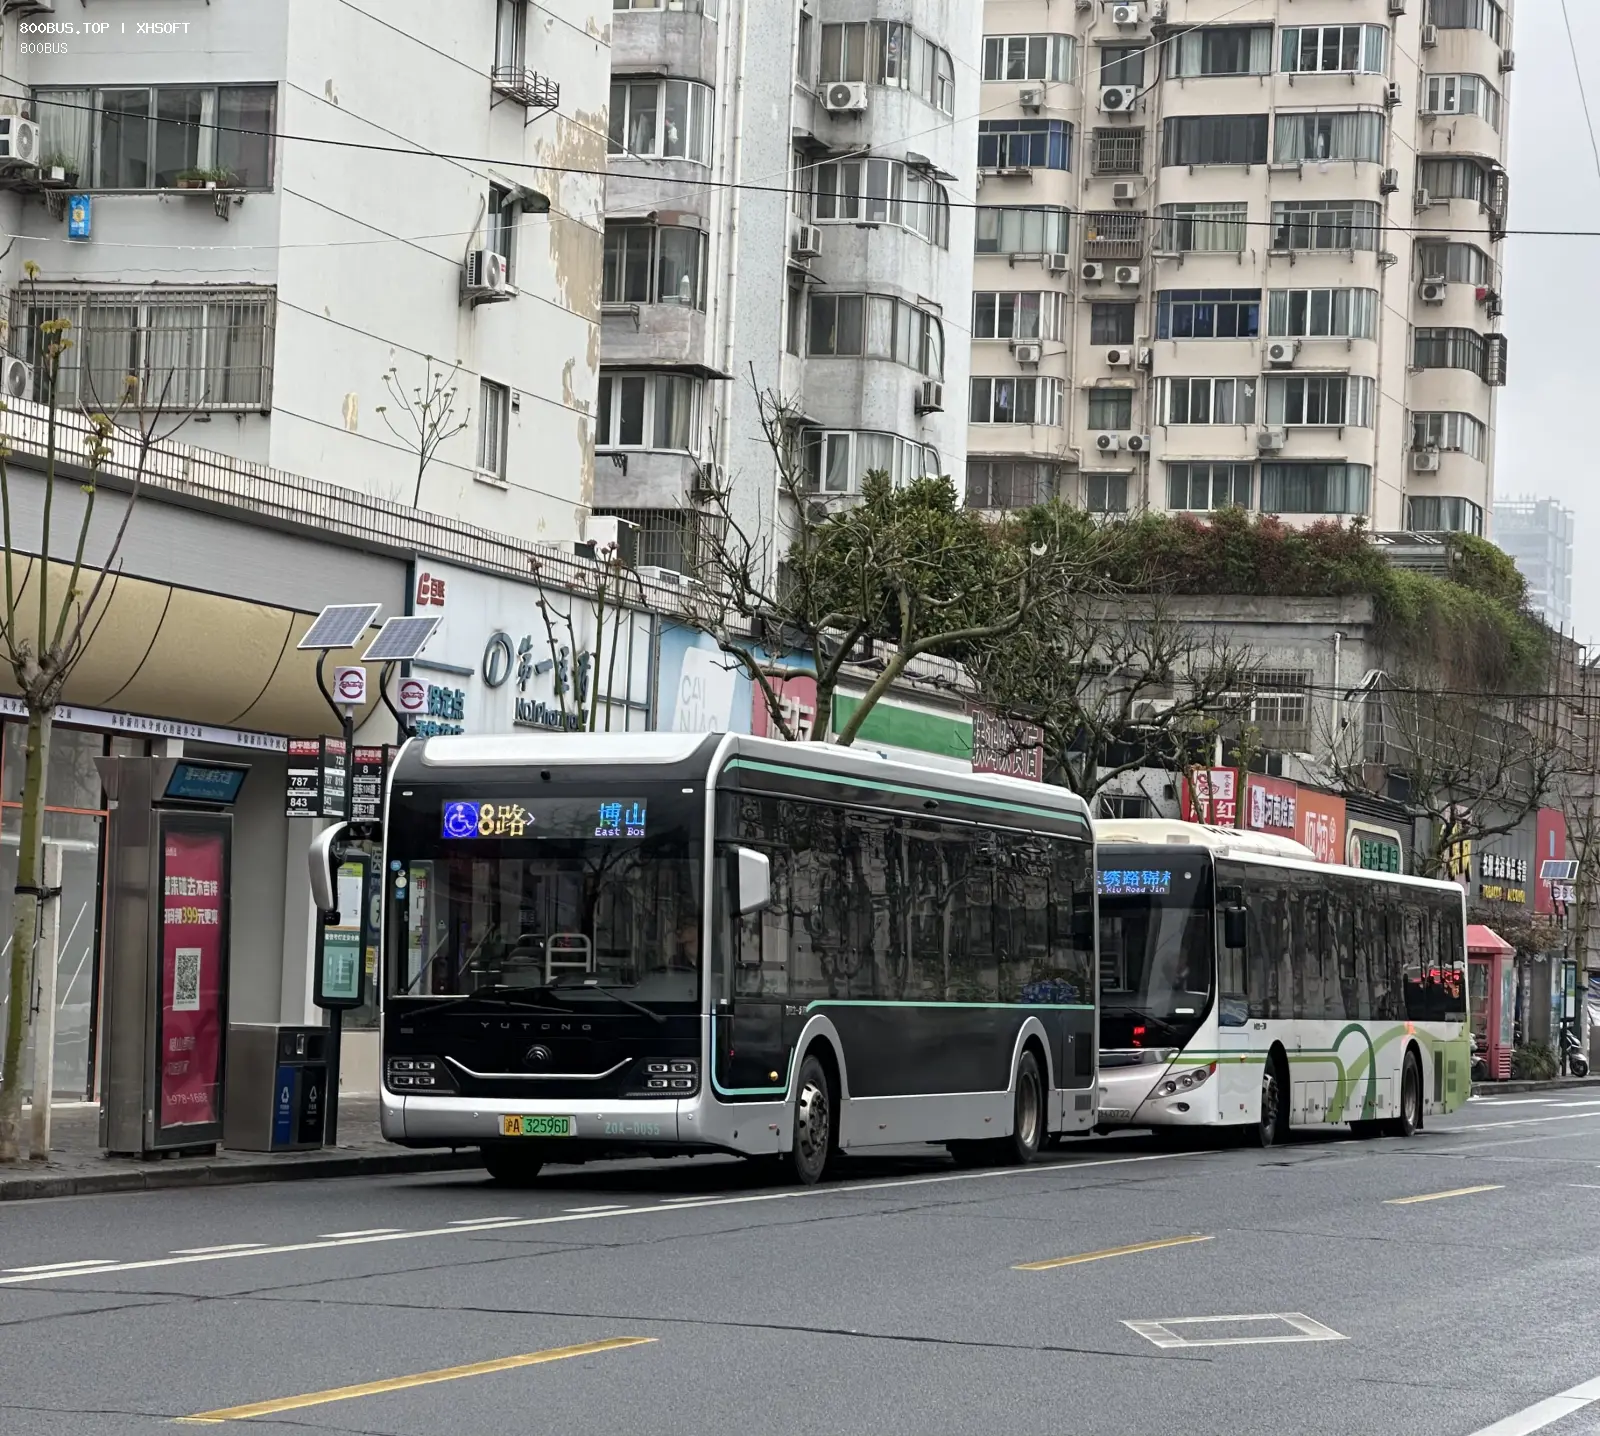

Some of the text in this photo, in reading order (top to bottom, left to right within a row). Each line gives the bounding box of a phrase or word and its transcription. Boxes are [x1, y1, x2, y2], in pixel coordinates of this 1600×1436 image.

[363, 765, 370, 775] 8
[291, 777, 309, 787] 787
[290, 797, 308, 808] 843
[478, 803, 526, 836] 8路
[598, 802, 646, 828] 博山
[595, 827, 621, 837] East
[481, 1021, 592, 1032] YUTONG
[525, 1118, 569, 1134] 32596D
